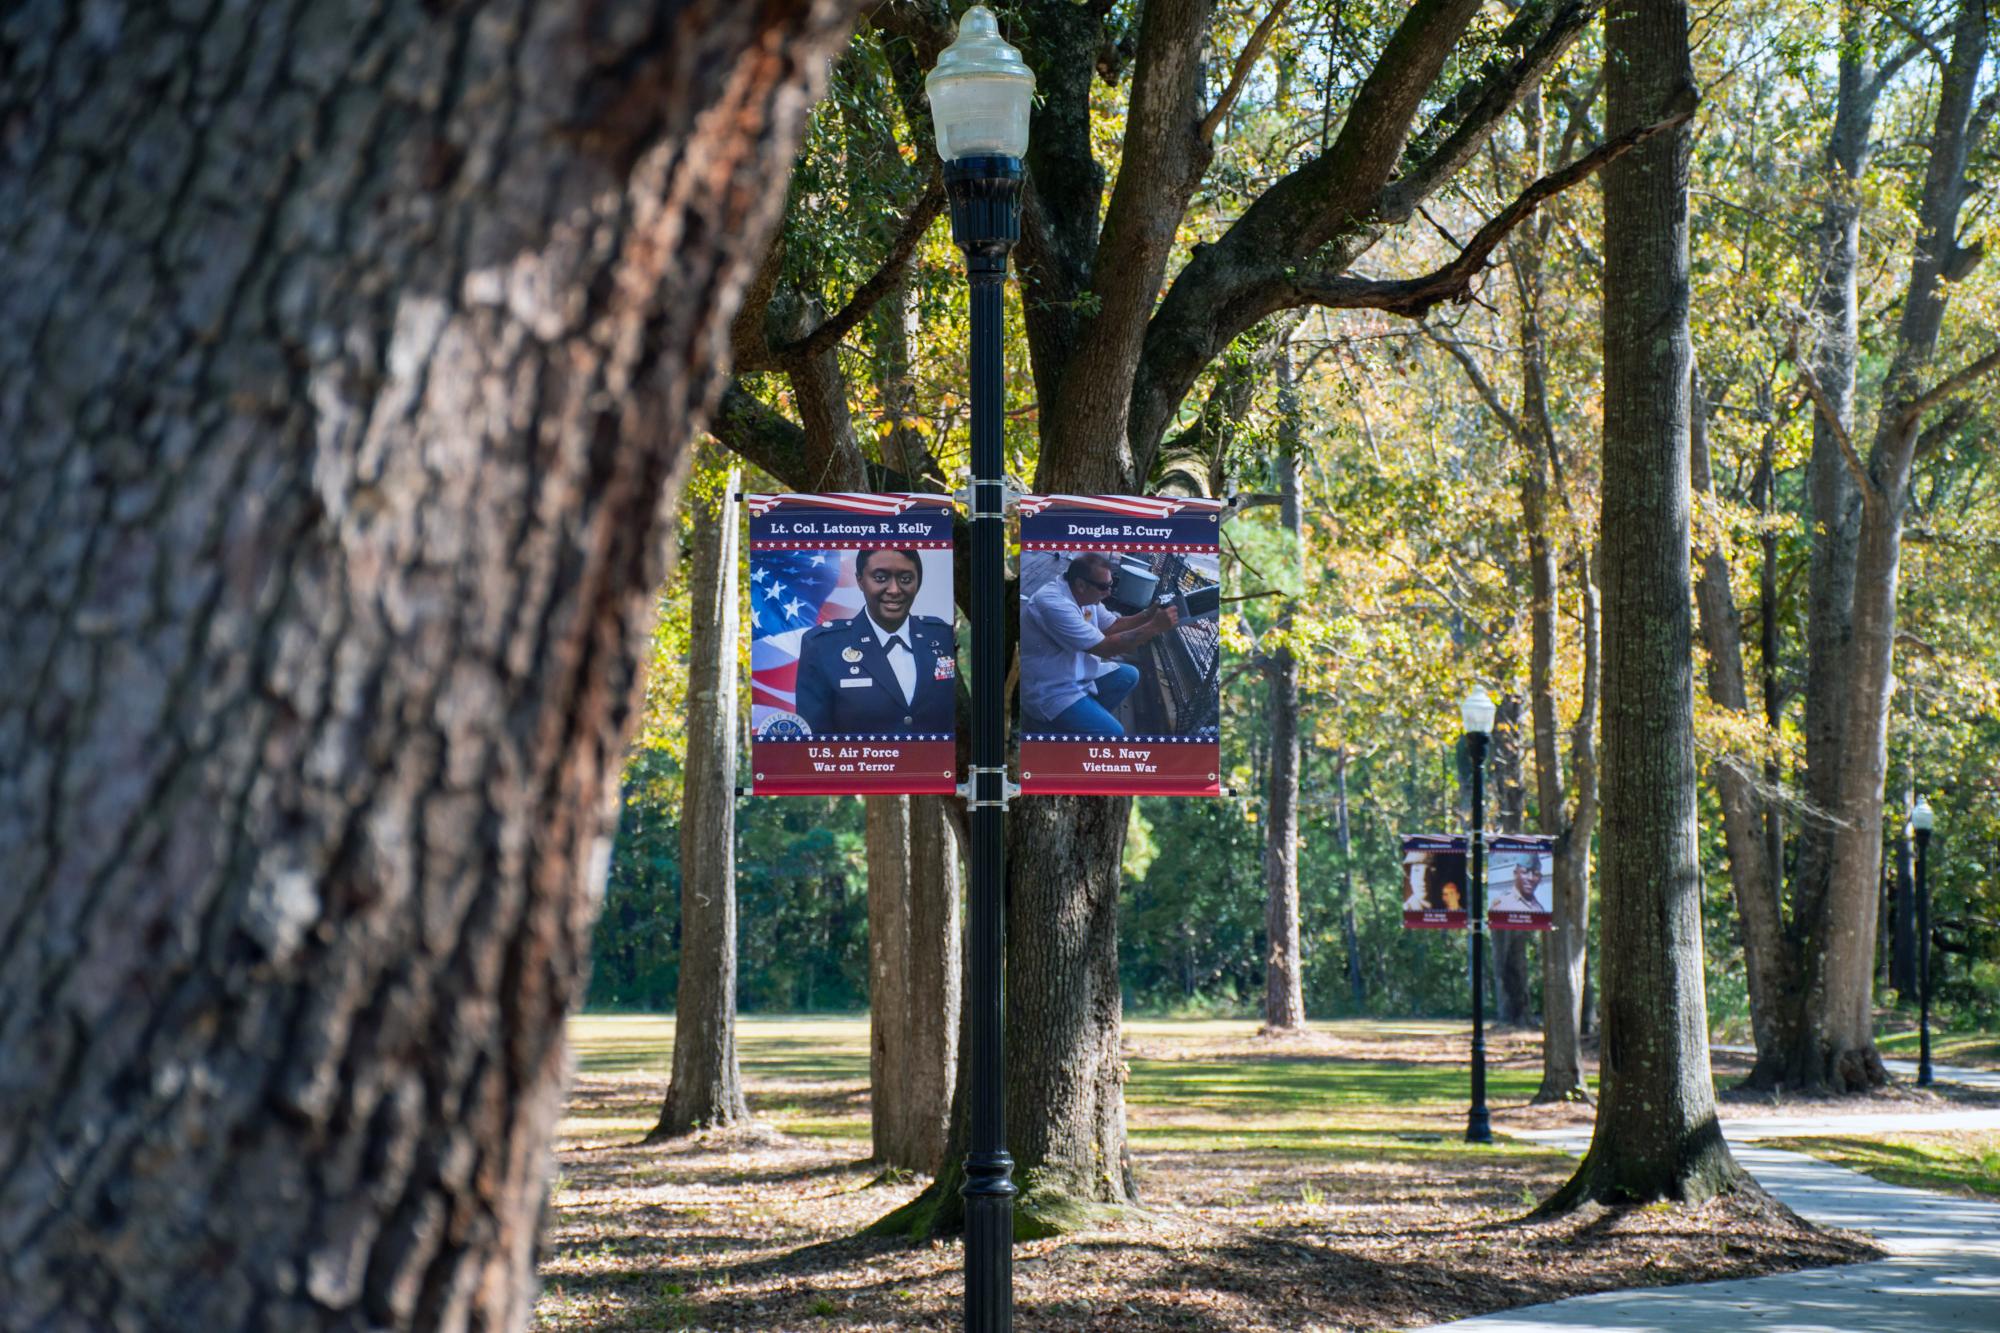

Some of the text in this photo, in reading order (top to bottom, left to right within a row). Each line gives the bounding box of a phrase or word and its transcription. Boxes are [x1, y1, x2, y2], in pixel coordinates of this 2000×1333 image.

[771, 523, 932, 536] Lt. Col. Latonya R. Kelly
[1068, 524, 1172, 539] Douglas E.Curry
[808, 747, 900, 758] U.S. Air Force
[1088, 748, 1151, 762] U.S. Navy
[813, 761, 895, 772] War on Terror
[1082, 762, 1157, 773] Vietnam War
